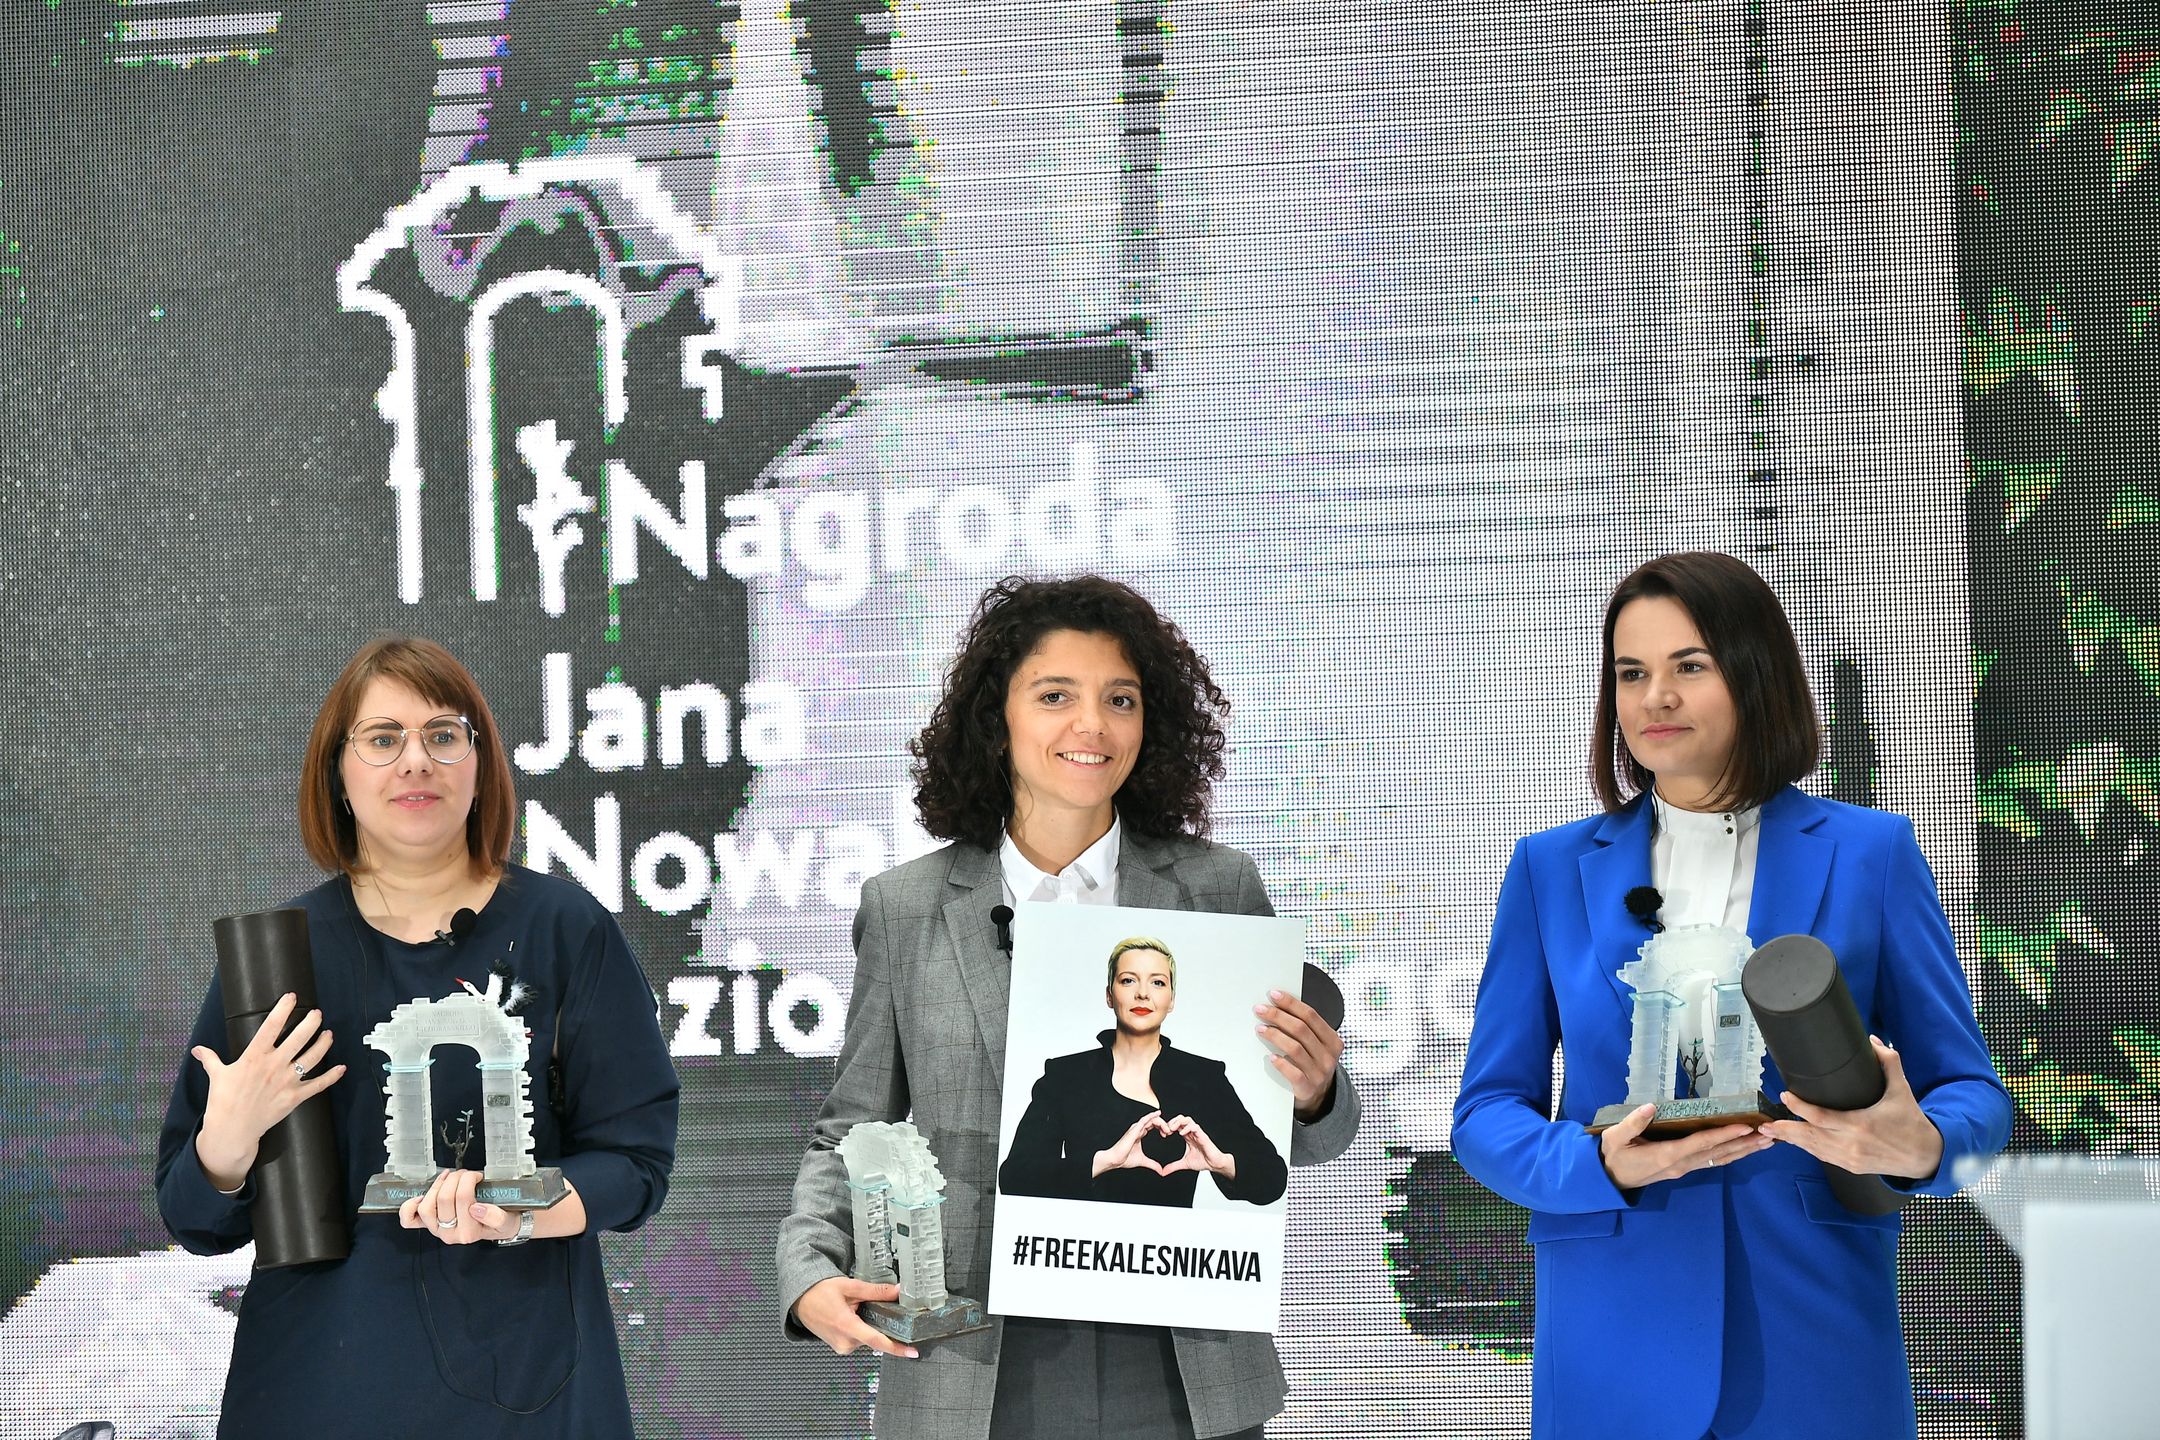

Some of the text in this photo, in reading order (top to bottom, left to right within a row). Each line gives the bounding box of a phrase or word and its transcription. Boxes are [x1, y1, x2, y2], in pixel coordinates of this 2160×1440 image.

[607, 441, 1178, 612] Nagroda
[514, 651, 807, 773] Jana
[1013, 1235, 1262, 1283] #FREEKALESNIKAVA
